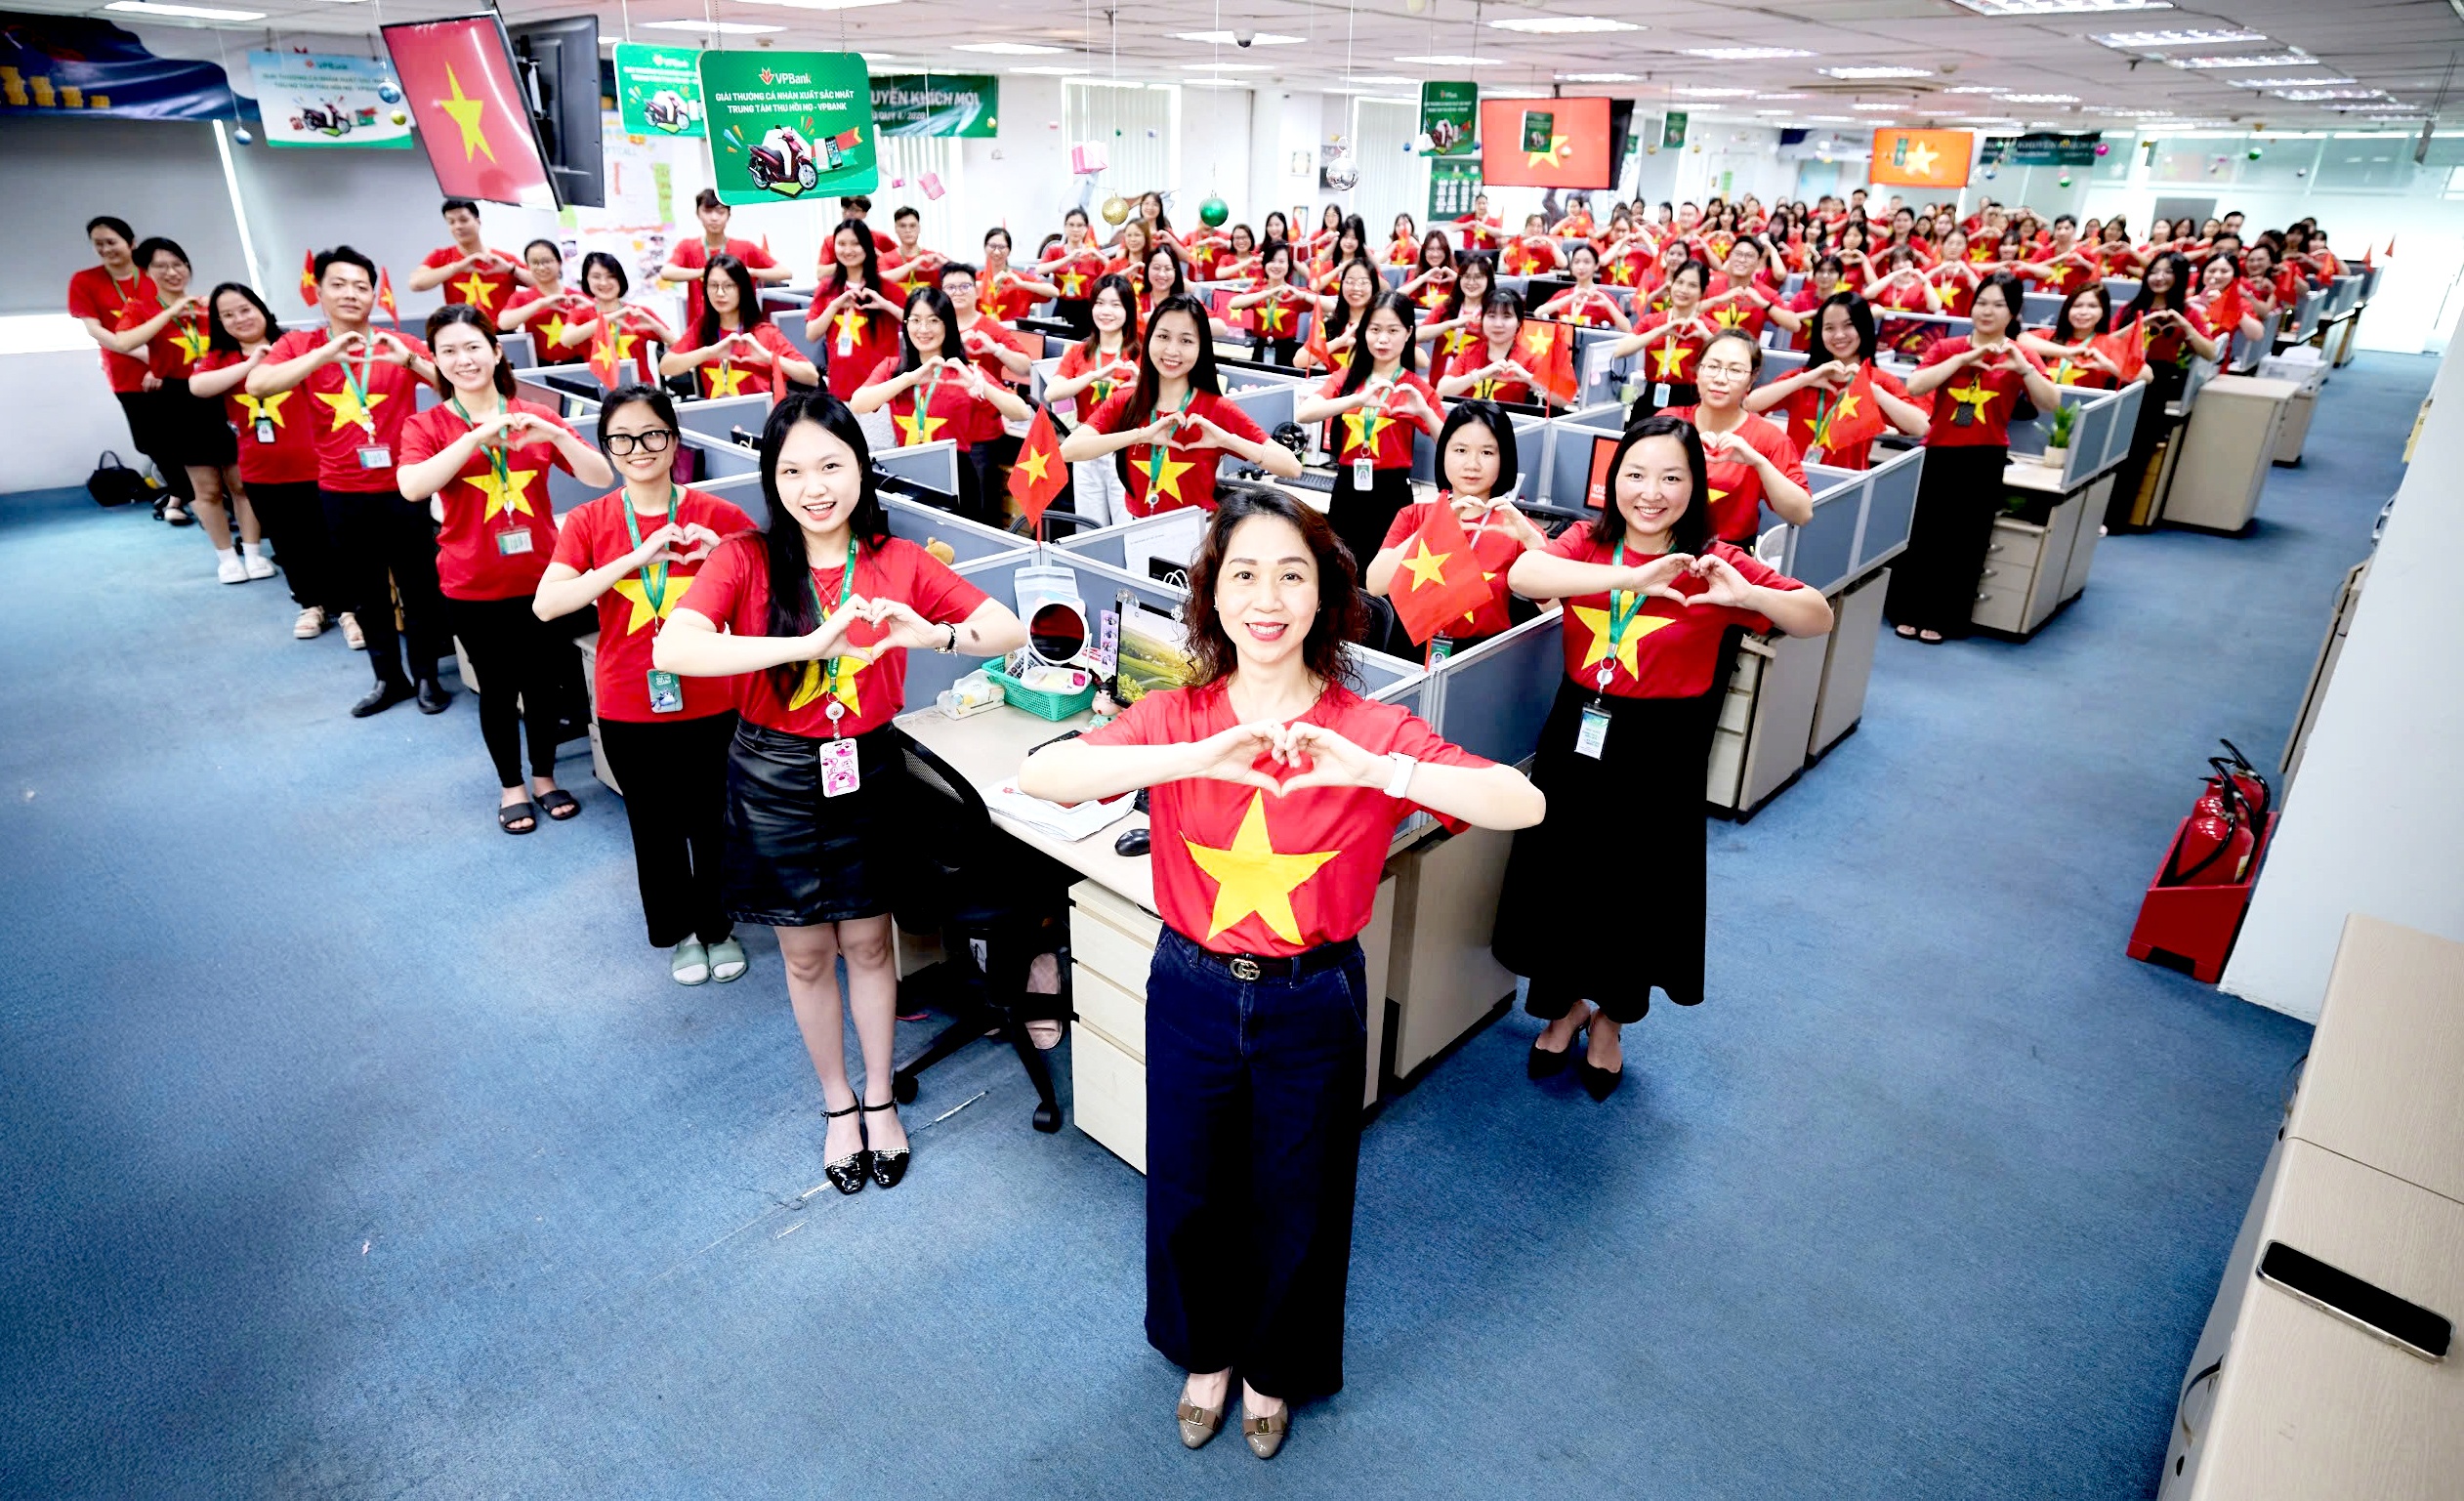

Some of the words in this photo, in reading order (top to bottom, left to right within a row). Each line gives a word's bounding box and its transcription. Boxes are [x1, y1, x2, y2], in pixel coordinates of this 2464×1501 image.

[774, 73, 812, 85] VPBank
[727, 104, 754, 113] TRUNG
[773, 104, 788, 112] THU
[817, 103, 847, 111] VPBANK
